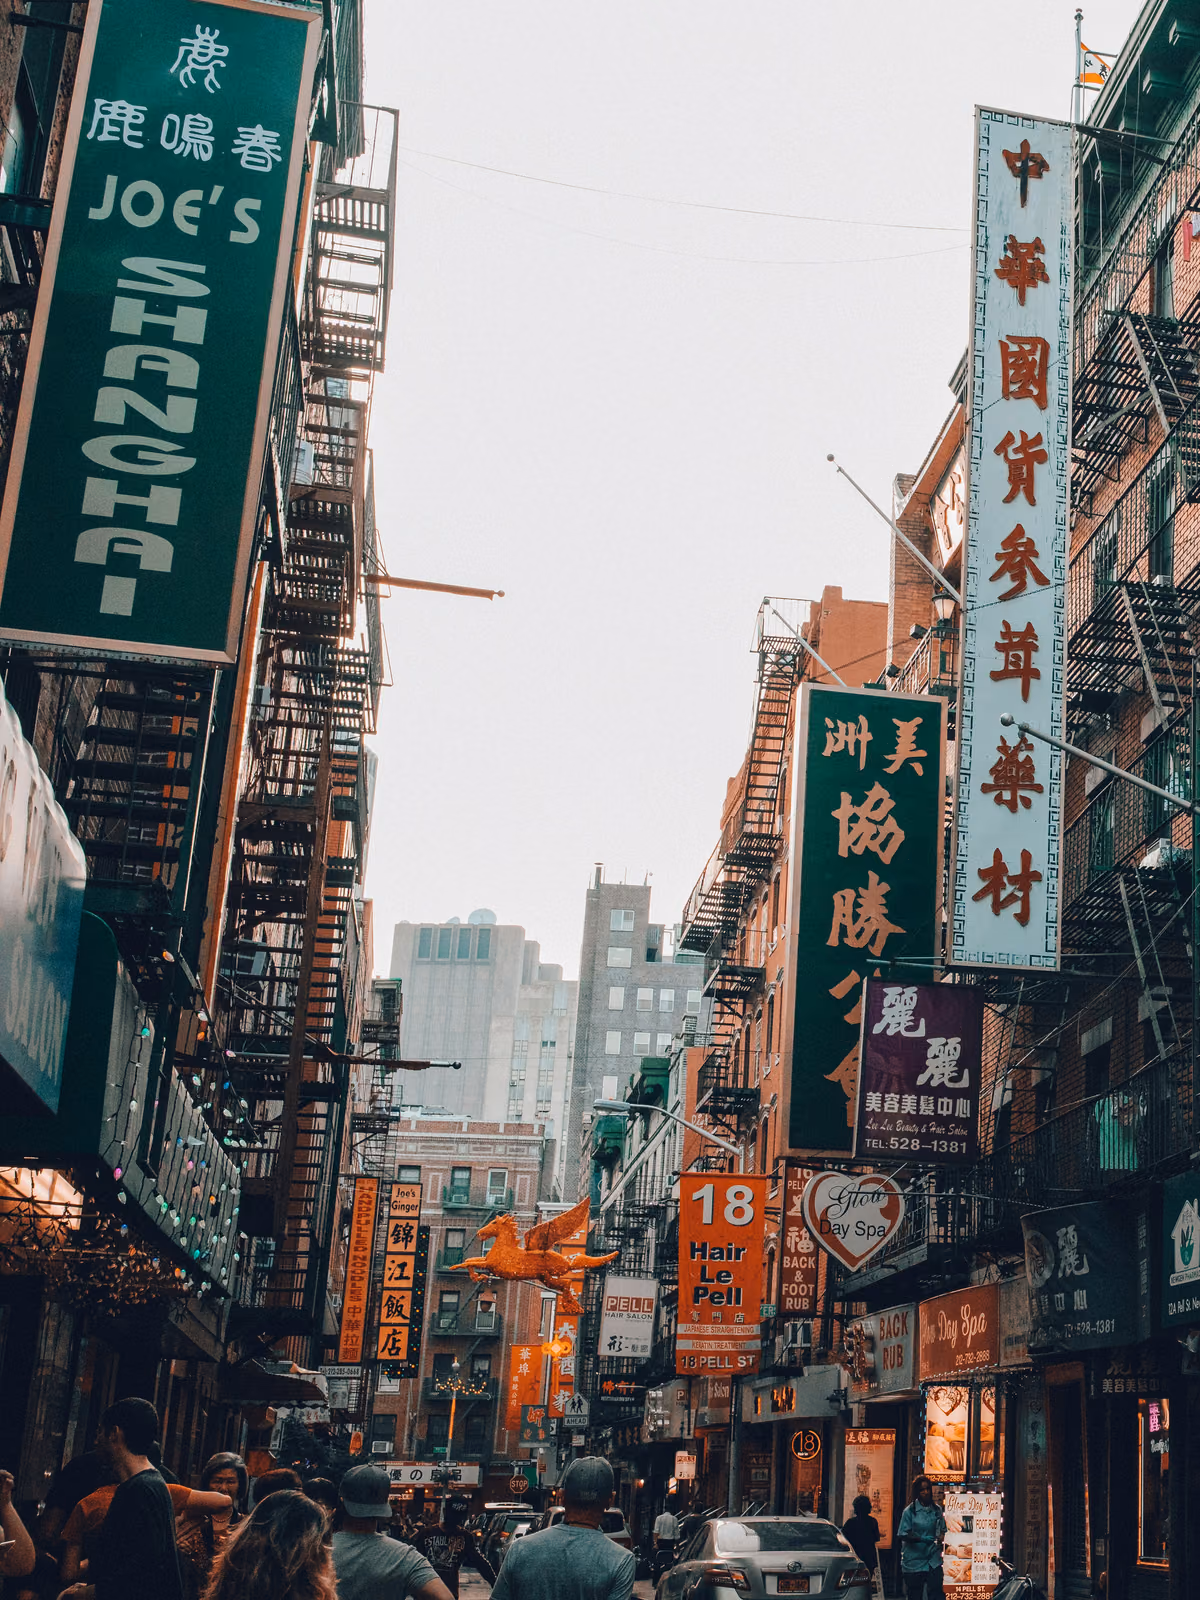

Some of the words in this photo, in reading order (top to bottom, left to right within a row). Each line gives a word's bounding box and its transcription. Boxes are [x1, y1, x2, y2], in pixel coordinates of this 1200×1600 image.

[86, 97, 283, 173] 鹿鳴春
[88, 174, 262, 244] JOE'S
[74, 256, 210, 617] SHANGHAI
[865, 1091, 971, 1119] 美容美髮中心
[880, 1118, 894, 1131] Lee
[896, 1119, 919, 1135] Beauty
[921, 1123, 928, 1133] &
[947, 1123, 968, 1136] Salon
[395, 1187, 415, 1198] Joe's
[826, 1183, 889, 1220] Glow
[392, 1200, 419, 1213] Ginger
[692, 1183, 754, 1227] 18
[820, 1219, 850, 1239] Day
[855, 1221, 886, 1240] Spa
[690, 1242, 747, 1262] Hair
[783, 1256, 815, 1268] BACK
[700, 1265, 733, 1286] Le
[794, 1270, 804, 1283] &
[380, 1221, 415, 1358] 錦江飯店
[693, 1286, 743, 1307] Pell
[782, 1283, 815, 1296] FOOT
[607, 1297, 652, 1312] PELL
[785, 1297, 810, 1310] RUB
[684, 1325, 710, 1333] JAPANESE
[879, 1311, 909, 1341] BACK
[937, 1310, 958, 1348] Day
[961, 1304, 988, 1348] Spa
[681, 1355, 697, 1369] 18
[700, 1356, 734, 1368] PELL
[737, 1354, 756, 1368] ST
[883, 1343, 904, 1371] RUB
[566, 1417, 588, 1426] AHEAD
[800, 1430, 815, 1452] 18
[511, 1480, 528, 1489] STOP
